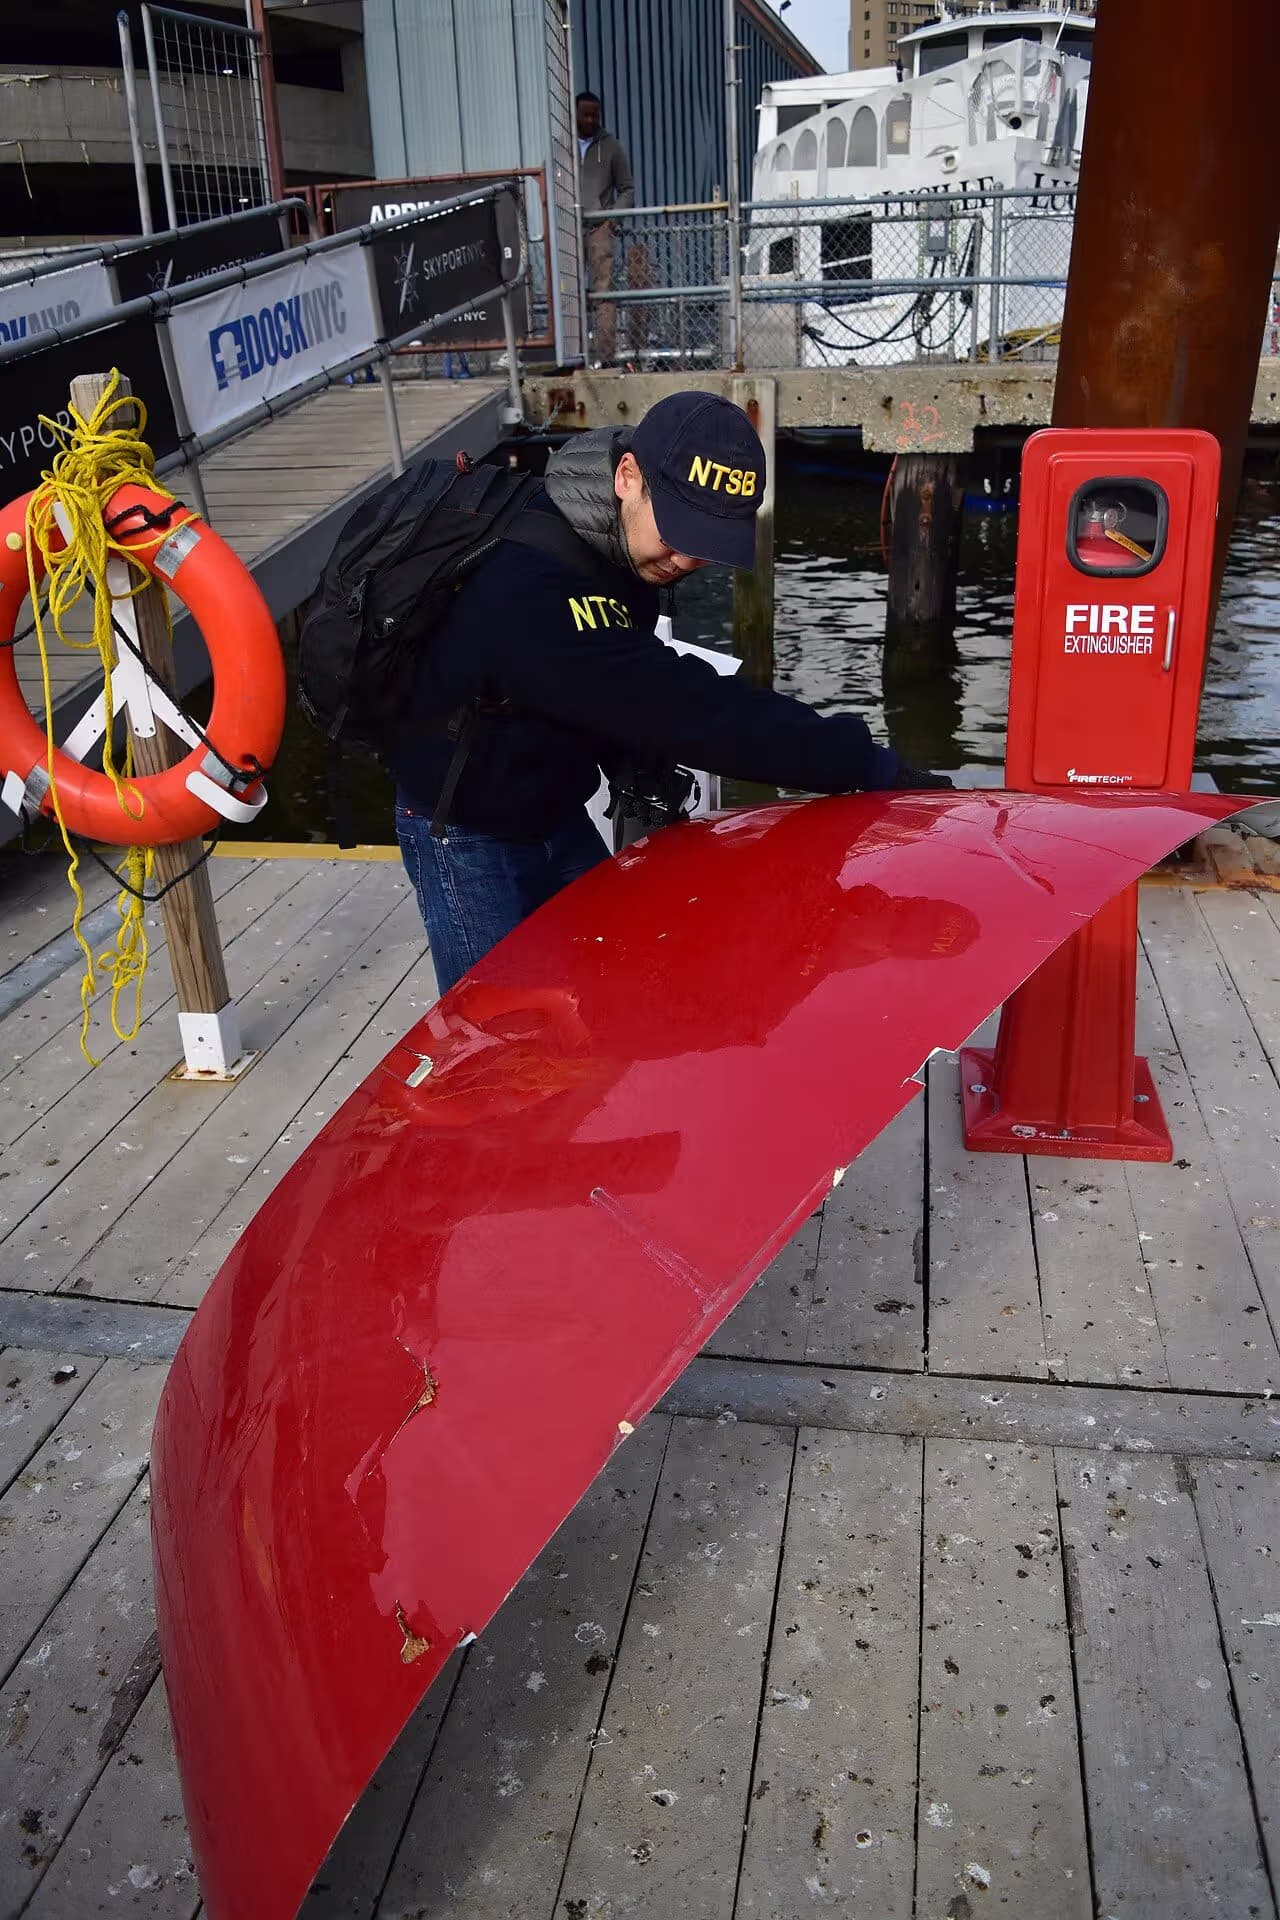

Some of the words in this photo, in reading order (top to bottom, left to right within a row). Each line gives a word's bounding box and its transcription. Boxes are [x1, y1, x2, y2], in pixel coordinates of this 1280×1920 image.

[687, 455, 757, 497] NTSB
[568, 596, 633, 631] NTS
[1065, 604, 1155, 634] FIRE
[1064, 635, 1153, 655] EXTINGUISHER
